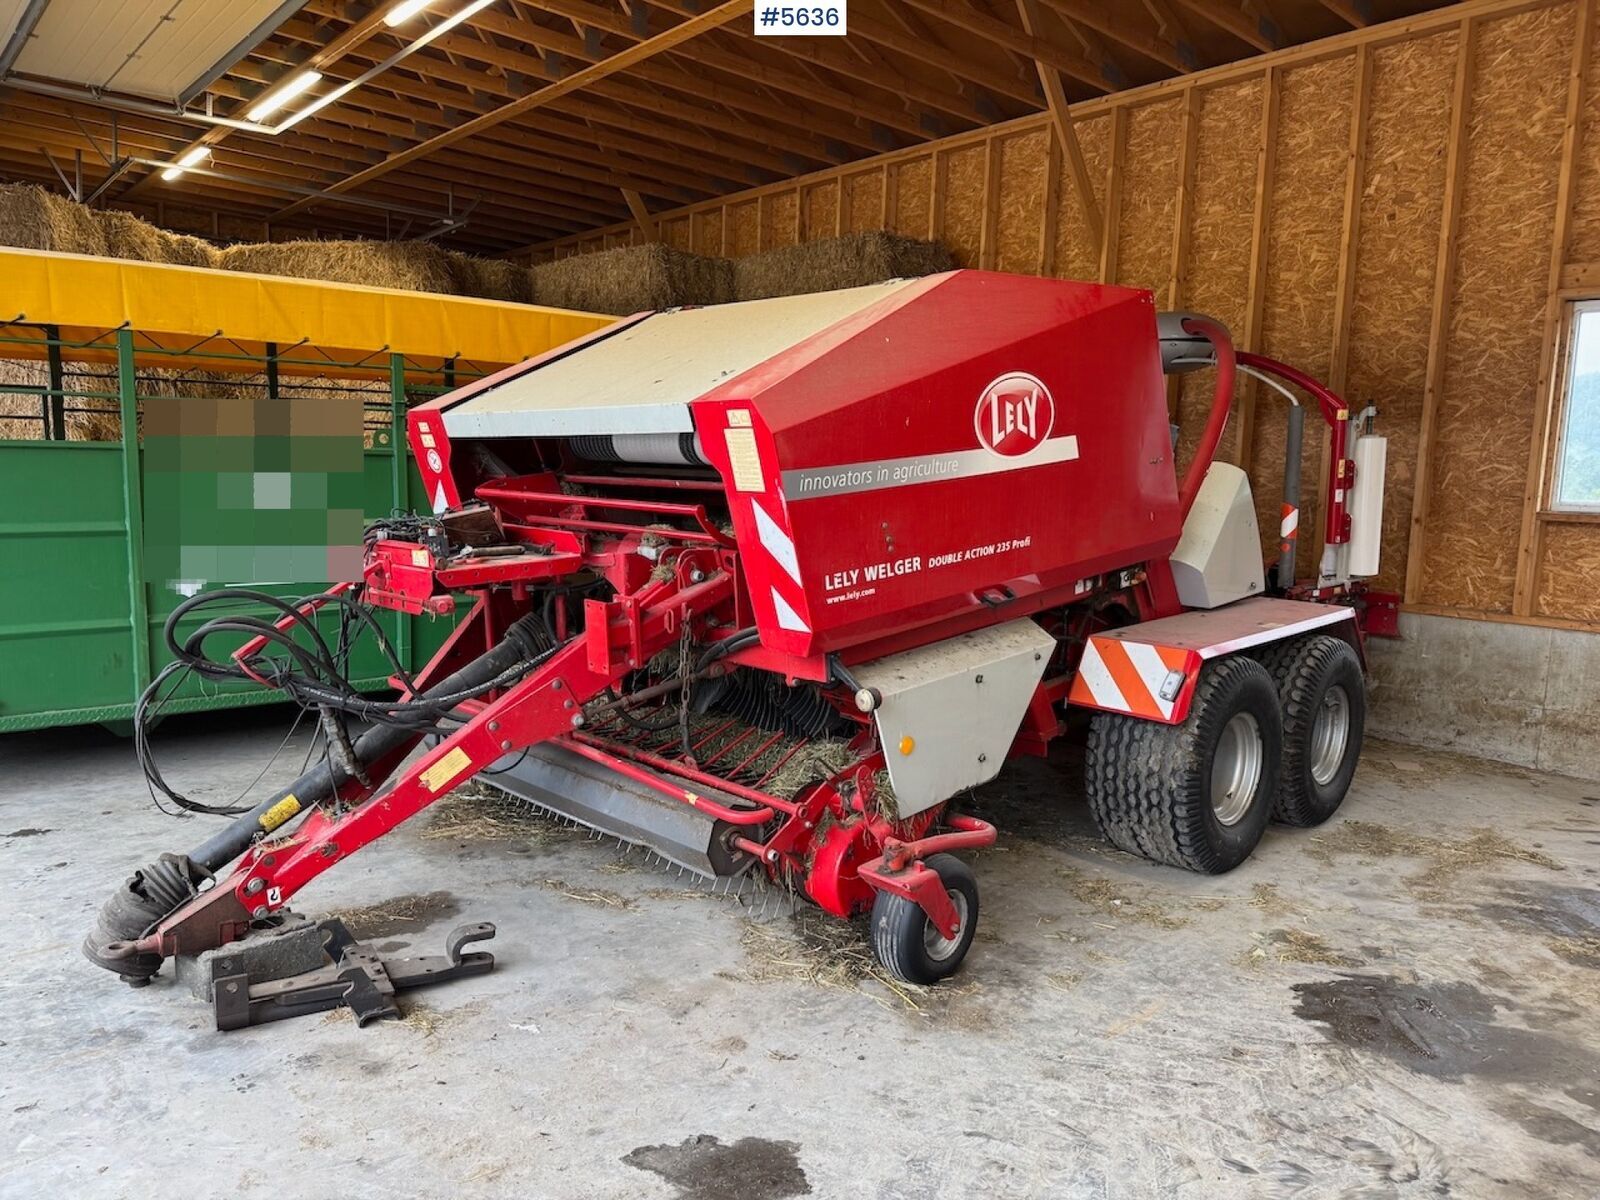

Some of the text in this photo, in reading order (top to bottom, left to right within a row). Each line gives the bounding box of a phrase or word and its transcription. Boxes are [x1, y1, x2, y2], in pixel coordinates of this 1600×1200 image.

[991, 387, 1039, 448] LELY
[799, 456, 960, 492] innovators in agriculture
[825, 535, 1032, 591] LELY WELGER DOUBLE ACTION 235 Profi
[826, 588, 876, 605] www.lely.com
